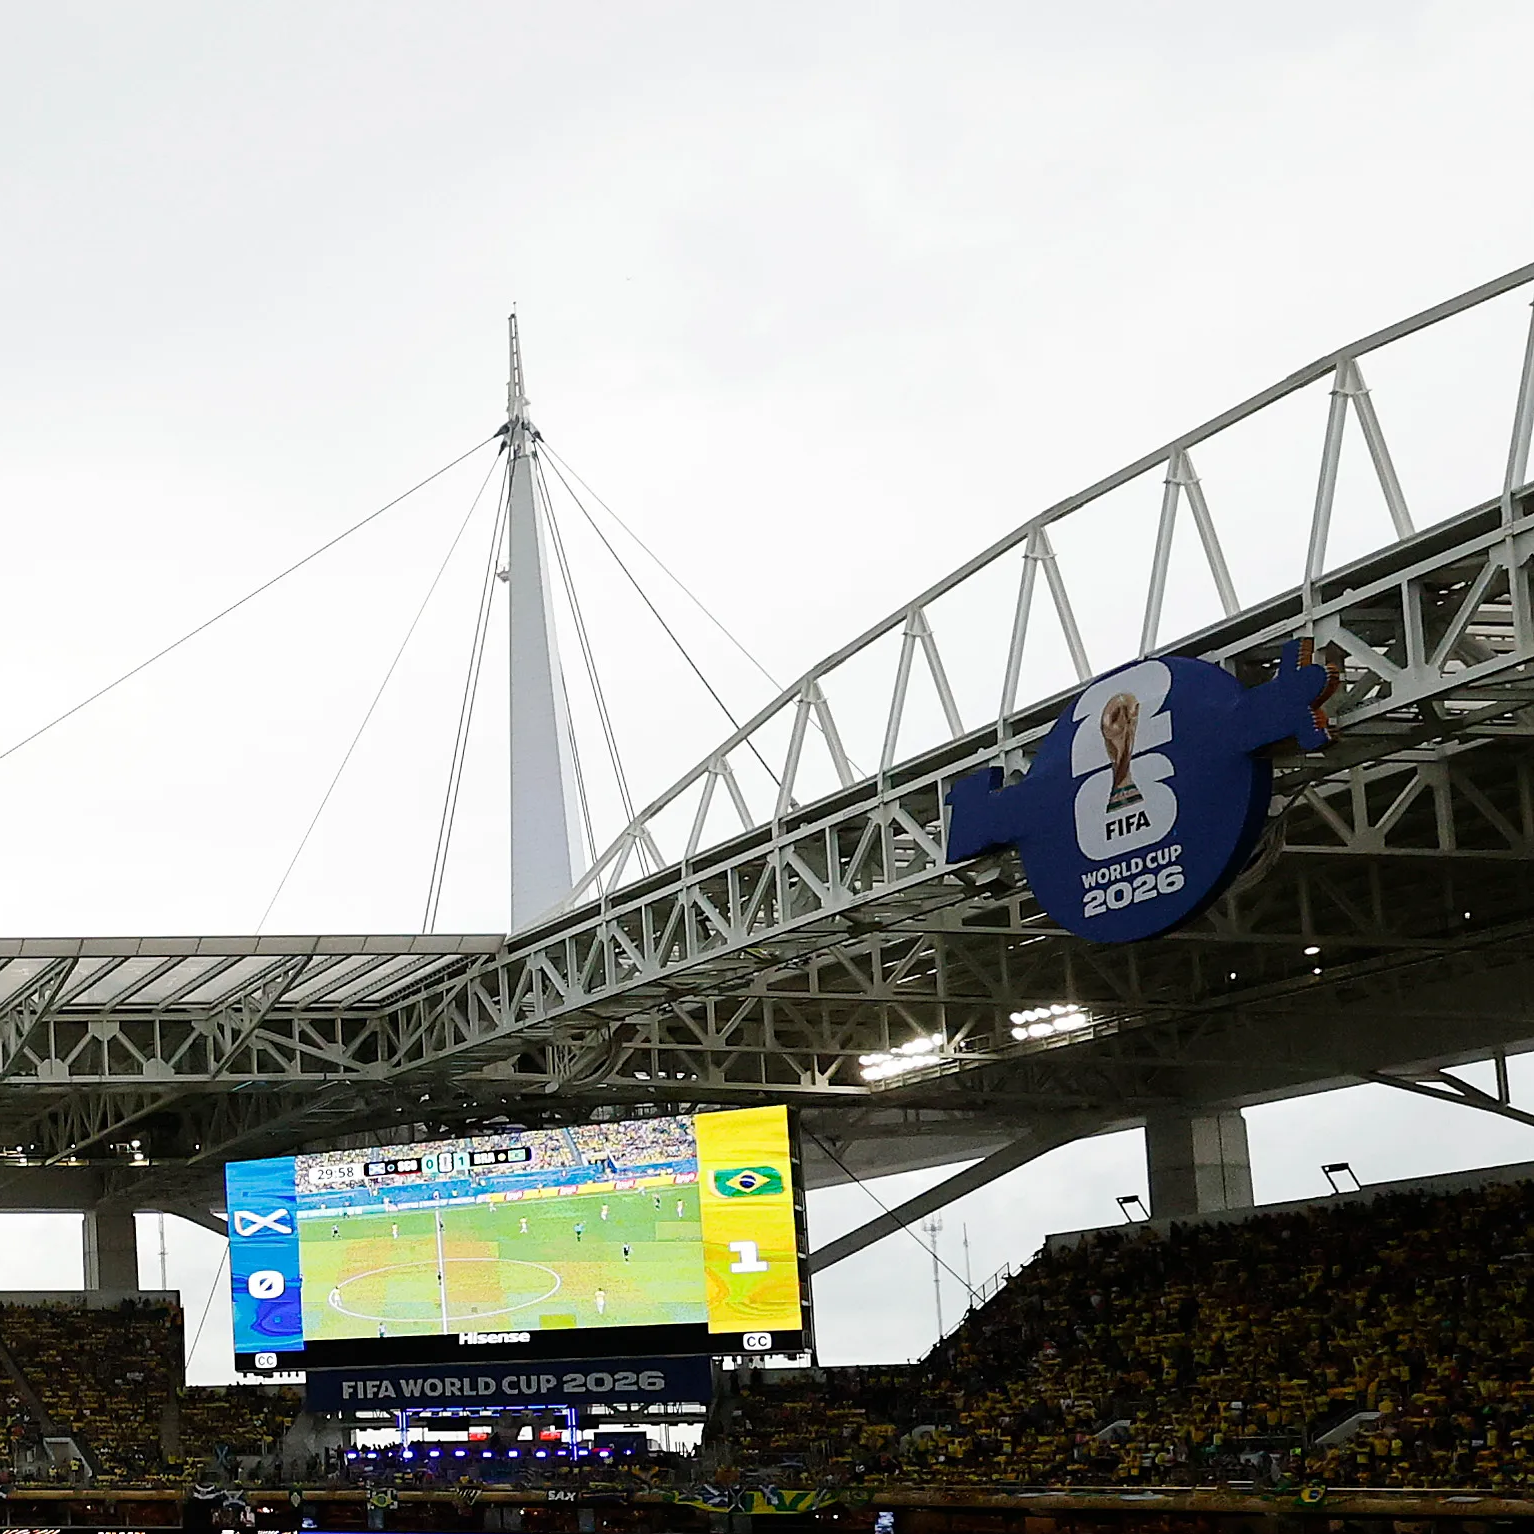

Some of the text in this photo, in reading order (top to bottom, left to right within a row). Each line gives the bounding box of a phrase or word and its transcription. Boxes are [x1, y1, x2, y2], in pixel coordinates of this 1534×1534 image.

[1105, 811, 1151, 841] FIFA
[1081, 845, 1182, 890] WORLD CUP
[1082, 866, 1185, 919] 2026
[317, 1166, 355, 1181] 29:58
[426, 1159, 434, 1170] 0
[728, 1240, 769, 1273] 1
[248, 1269, 285, 1300] 0
[459, 1329, 531, 1345] Hisense
[746, 1335, 767, 1348] CC
[342, 1370, 666, 1400] FIFA WORLD CUP 2026
